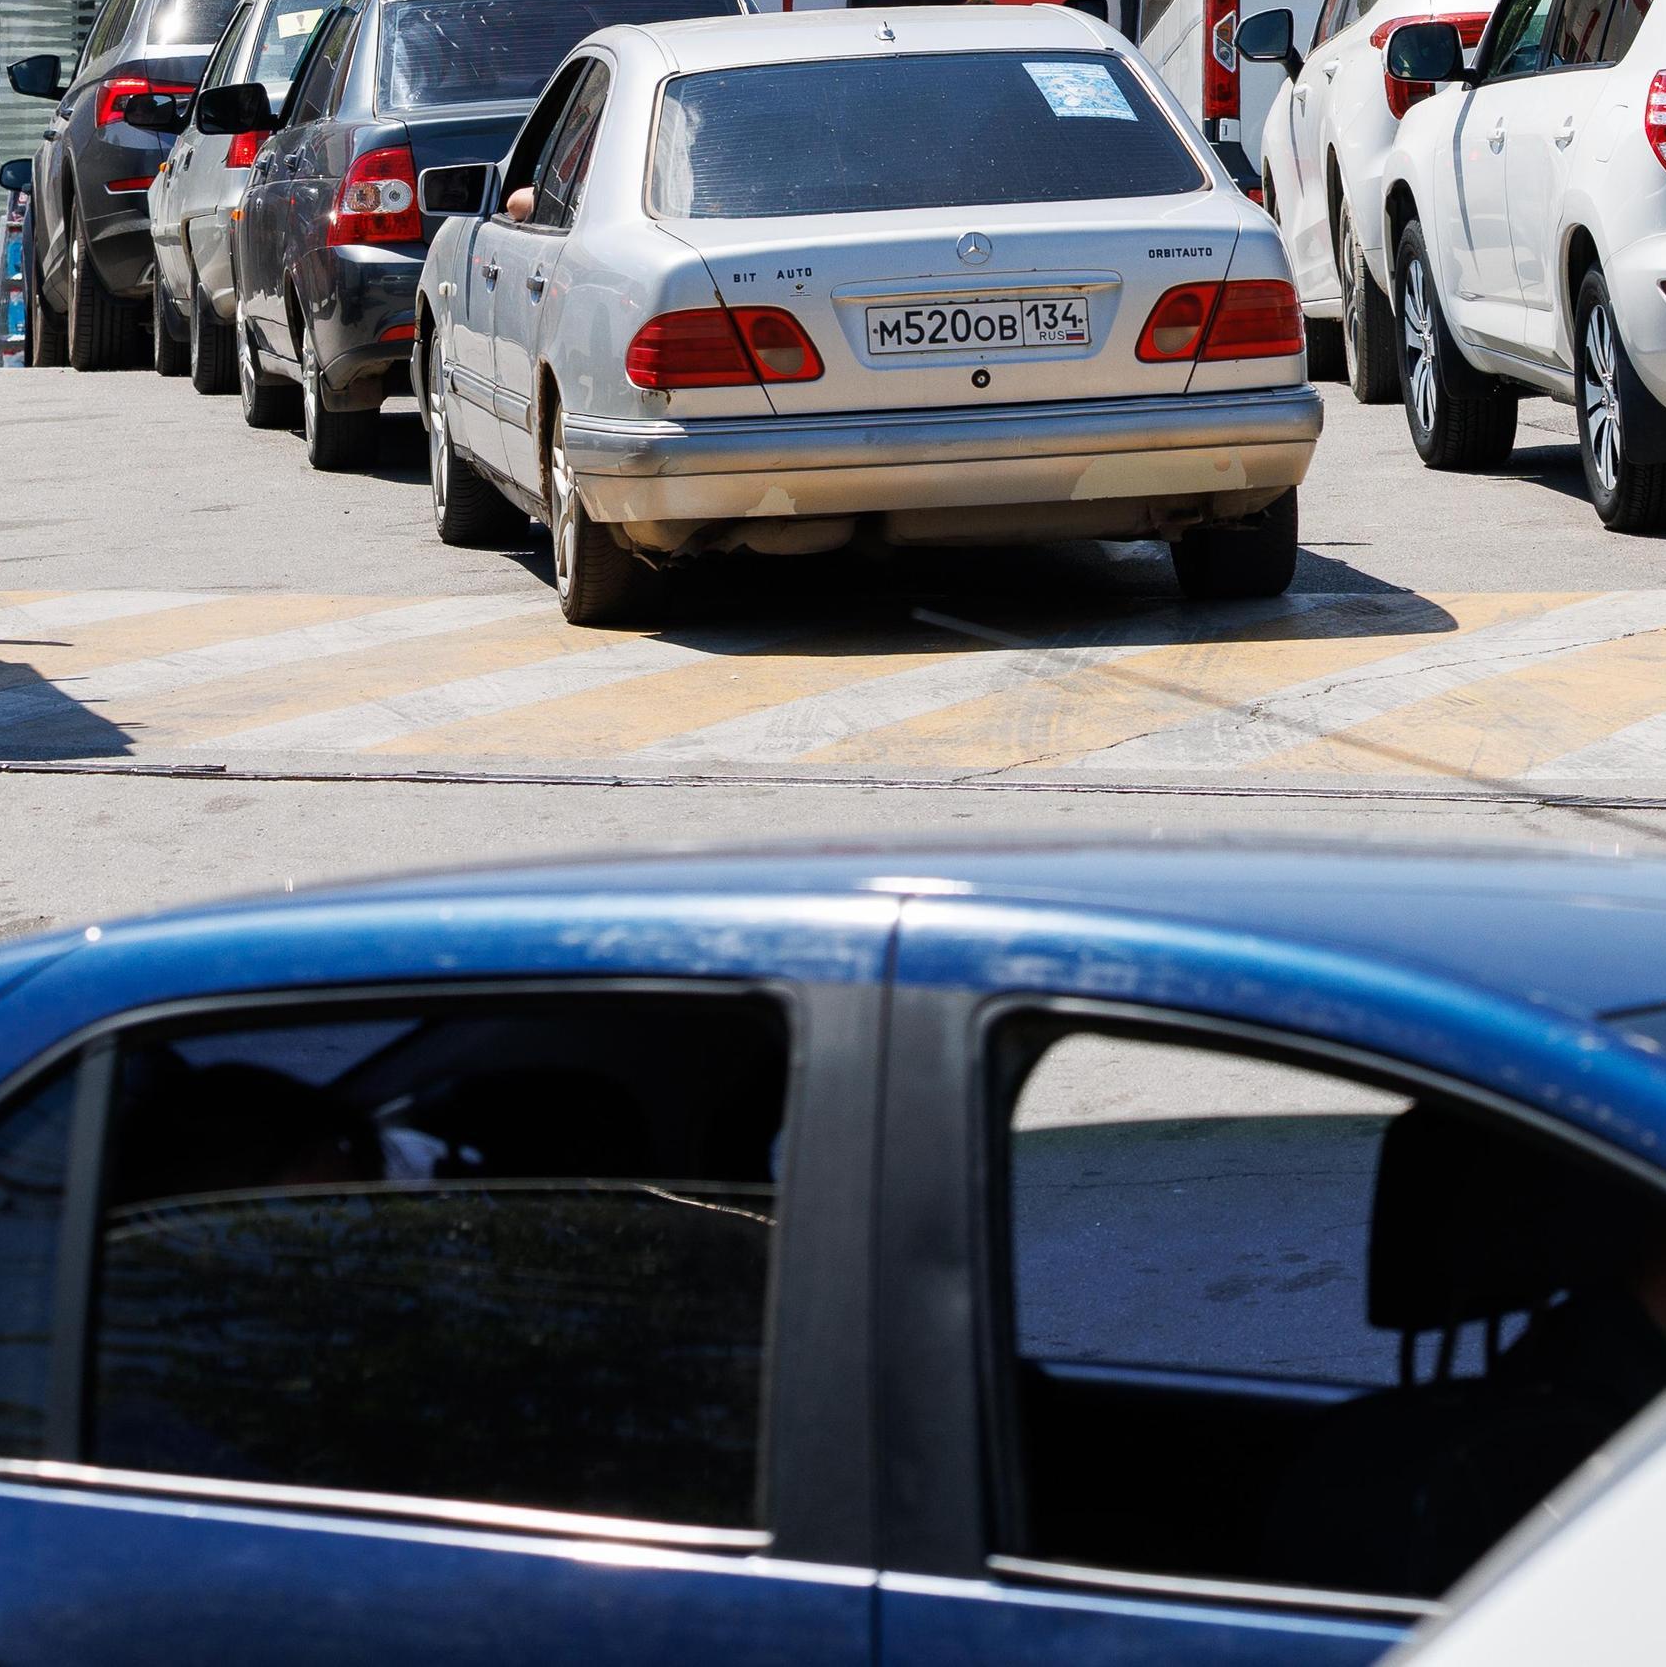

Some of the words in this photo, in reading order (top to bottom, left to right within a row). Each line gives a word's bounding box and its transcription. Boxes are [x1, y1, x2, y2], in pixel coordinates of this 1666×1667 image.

[1148, 247, 1213, 259] ORBITAUTO
[733, 272, 757, 283] BIT
[776, 267, 812, 280] AUTO
[879, 308, 1018, 346] М520ОВ
[1025, 302, 1077, 330] 134
[1039, 331, 1066, 341] RUS
